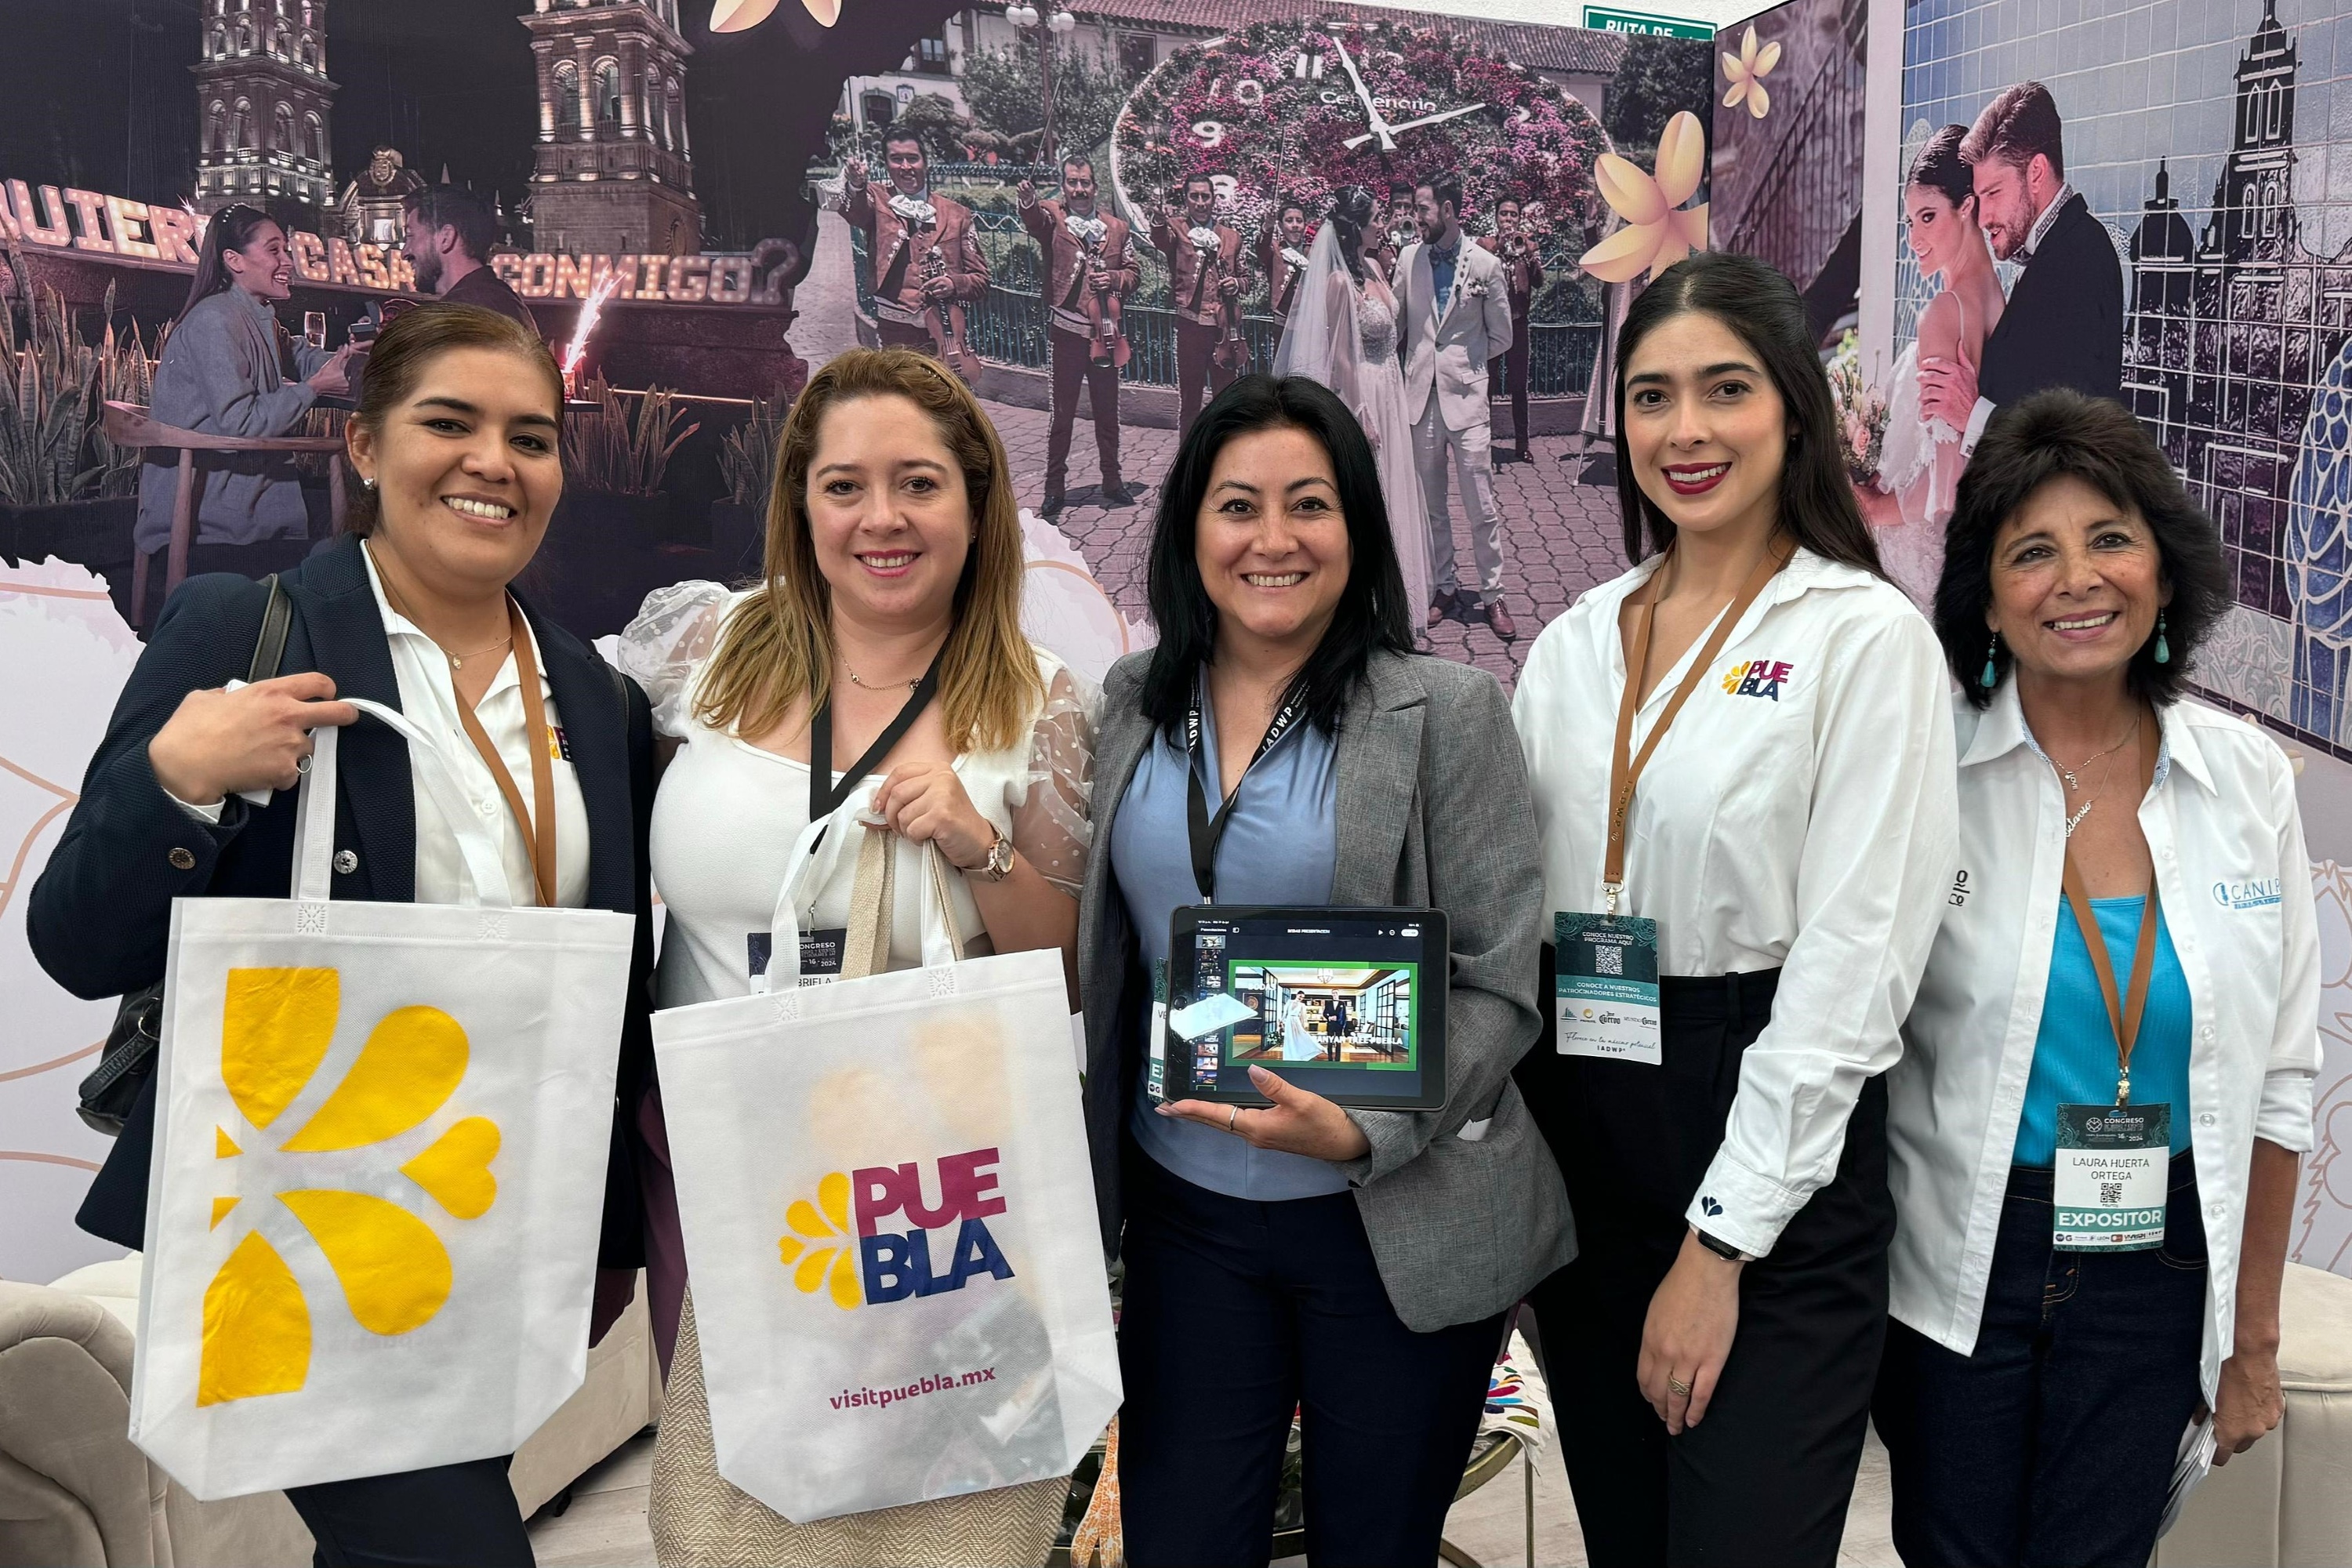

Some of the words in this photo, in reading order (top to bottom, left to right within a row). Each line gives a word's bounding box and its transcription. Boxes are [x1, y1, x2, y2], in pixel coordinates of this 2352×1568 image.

[1320, 91, 1436, 111] Cenenario
[0, 178, 211, 265] UIER
[1746, 660, 1794, 683] PUE
[1736, 677, 1778, 702] BLA
[1262, 706, 1293, 752] IADWP
[1558, 988, 1615, 997] PATROCINADORES
[1610, 984, 1640, 993] NUESTROS
[2073, 1157, 2108, 1167] LAURA
[2111, 1158, 2150, 1168] HUERTA
[2091, 1171, 2132, 1181] ORTEGA
[852, 1147, 1007, 1238] PUE
[2058, 1210, 2162, 1227] EXPOSITOR
[859, 1218, 1015, 1305] BLA
[829, 1367, 996, 1410] visitpuebla.mx
